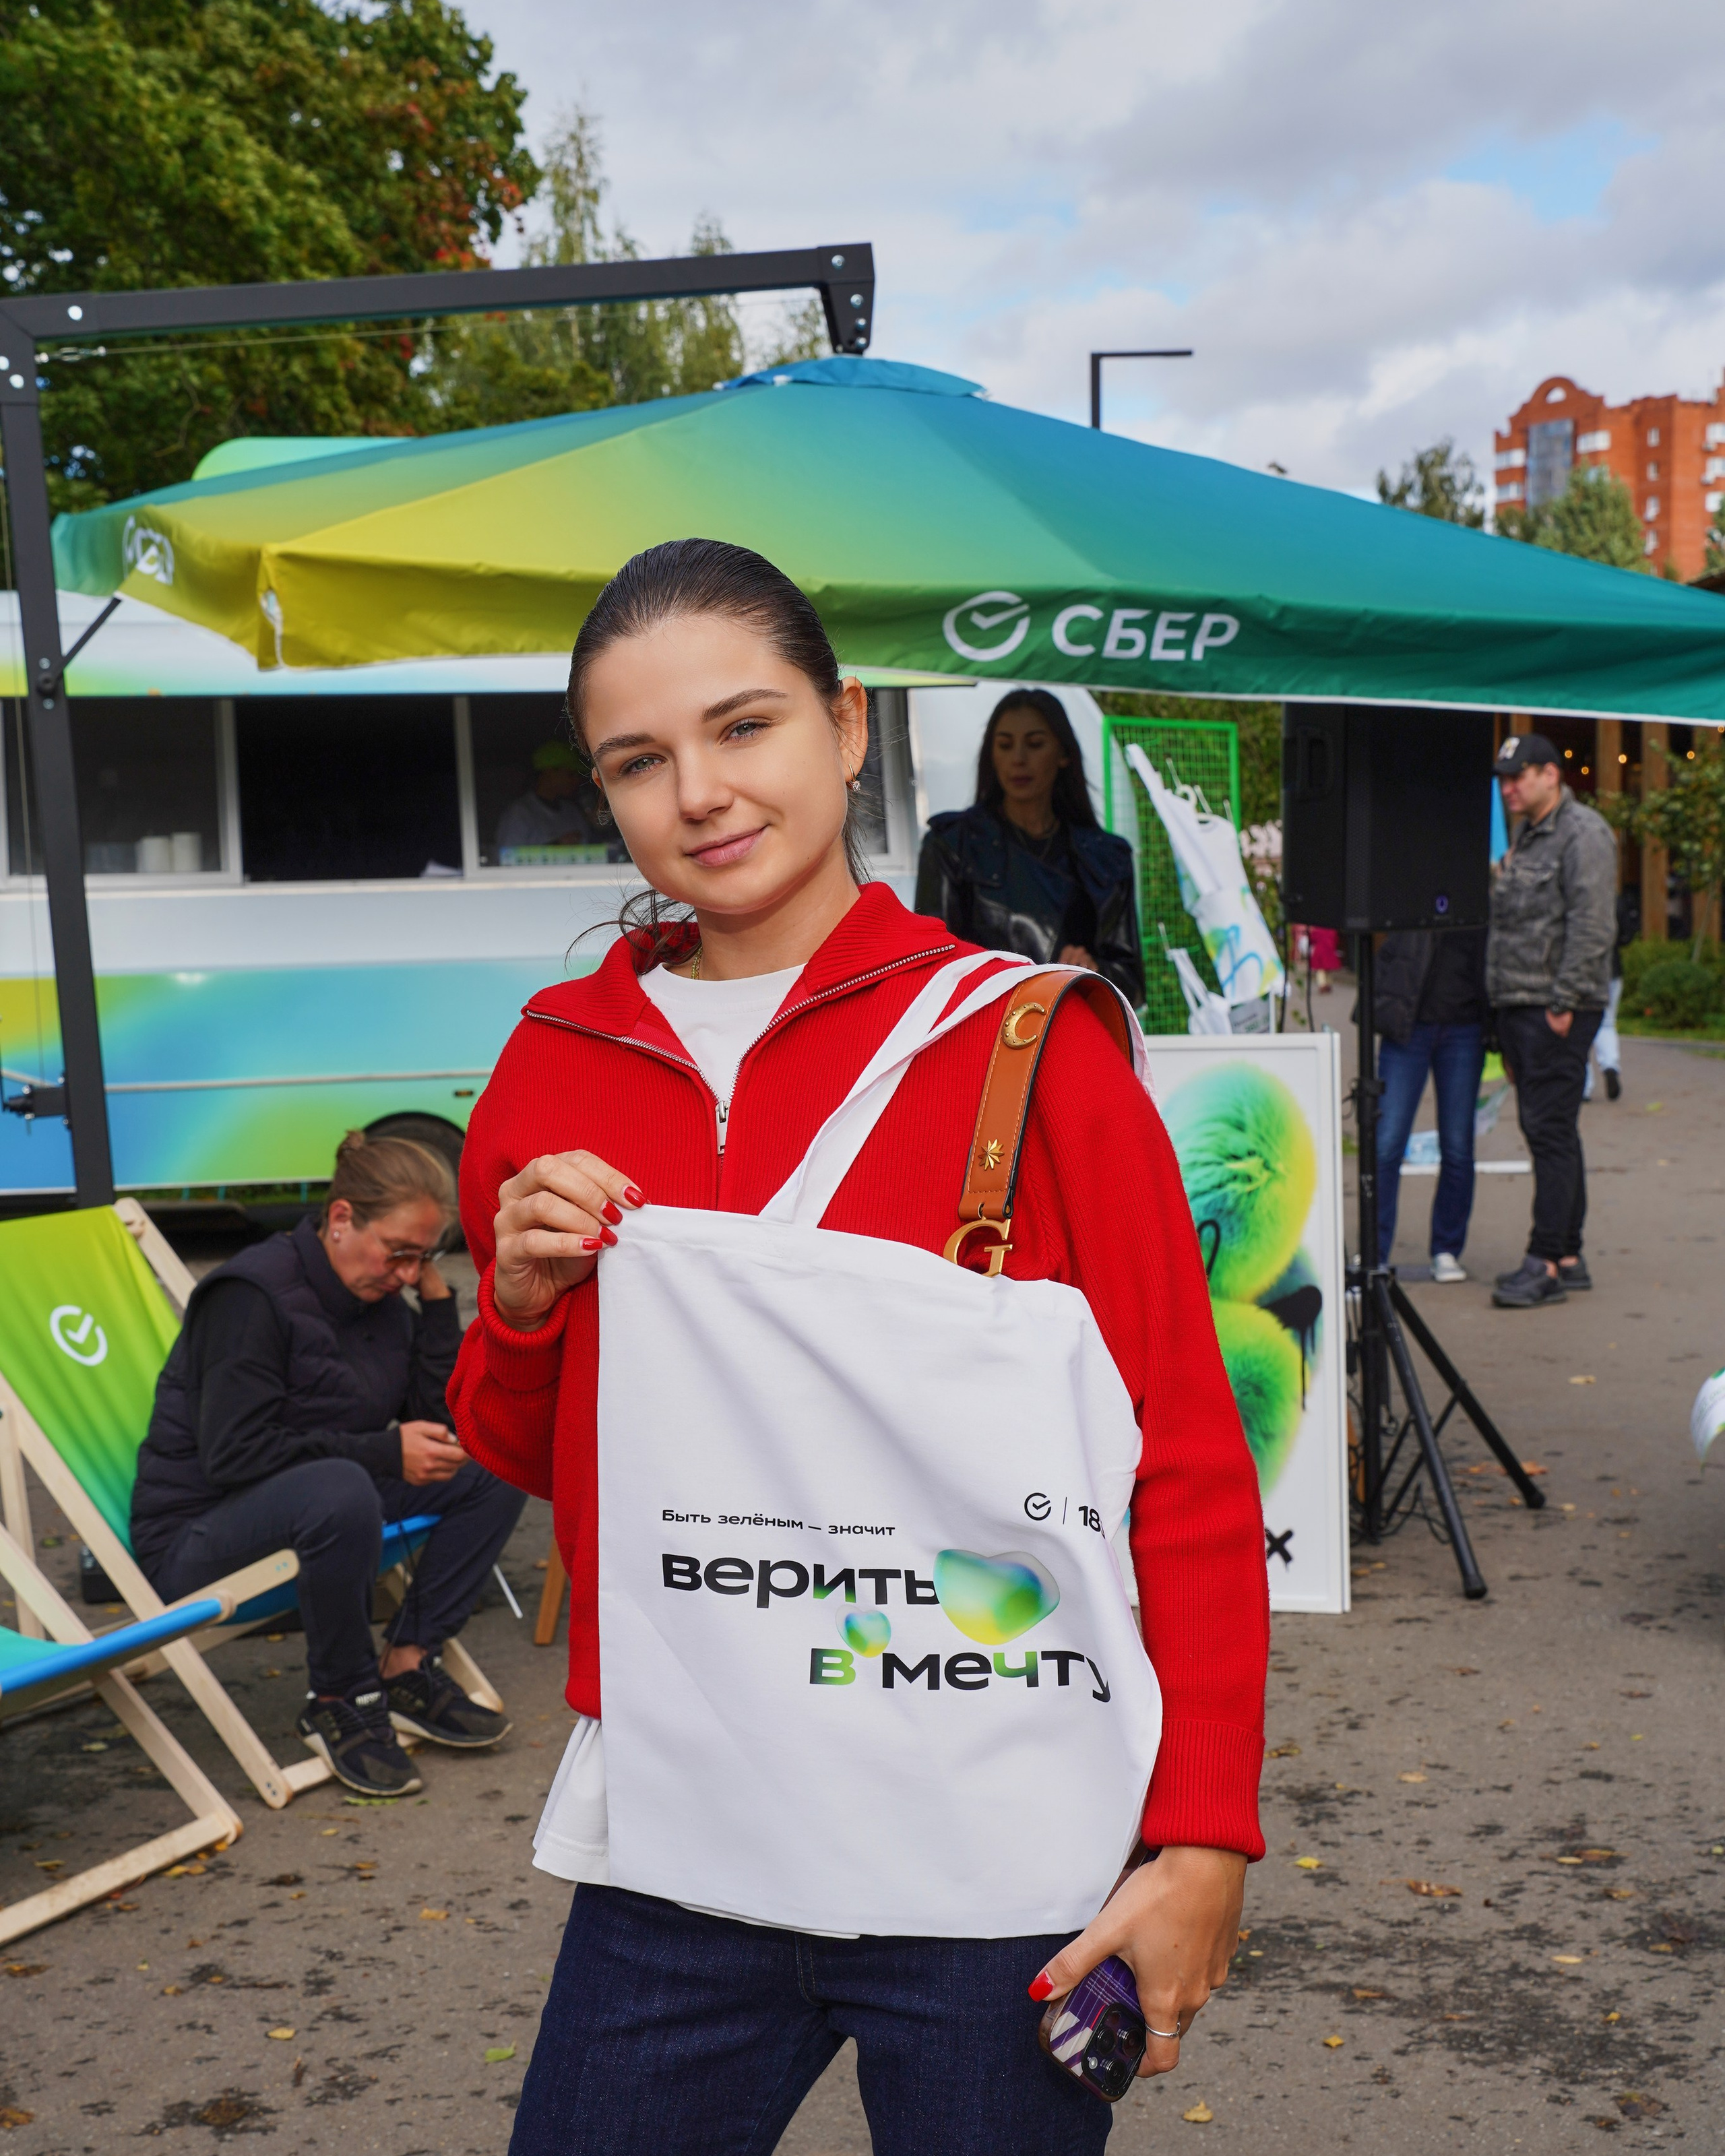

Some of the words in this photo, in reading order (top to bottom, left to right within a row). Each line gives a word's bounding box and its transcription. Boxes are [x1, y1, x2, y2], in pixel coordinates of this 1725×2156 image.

[1051, 604, 1241, 662] СБЕР
[662, 1509, 712, 1523] Быть
[718, 1513, 803, 1529] зелёным
[828, 1525, 896, 1536] значит
[1078, 1505, 1106, 1539] 18
[662, 1553, 940, 1609] верить
[809, 1647, 856, 1686] в
[882, 1650, 1111, 1703] мечту
